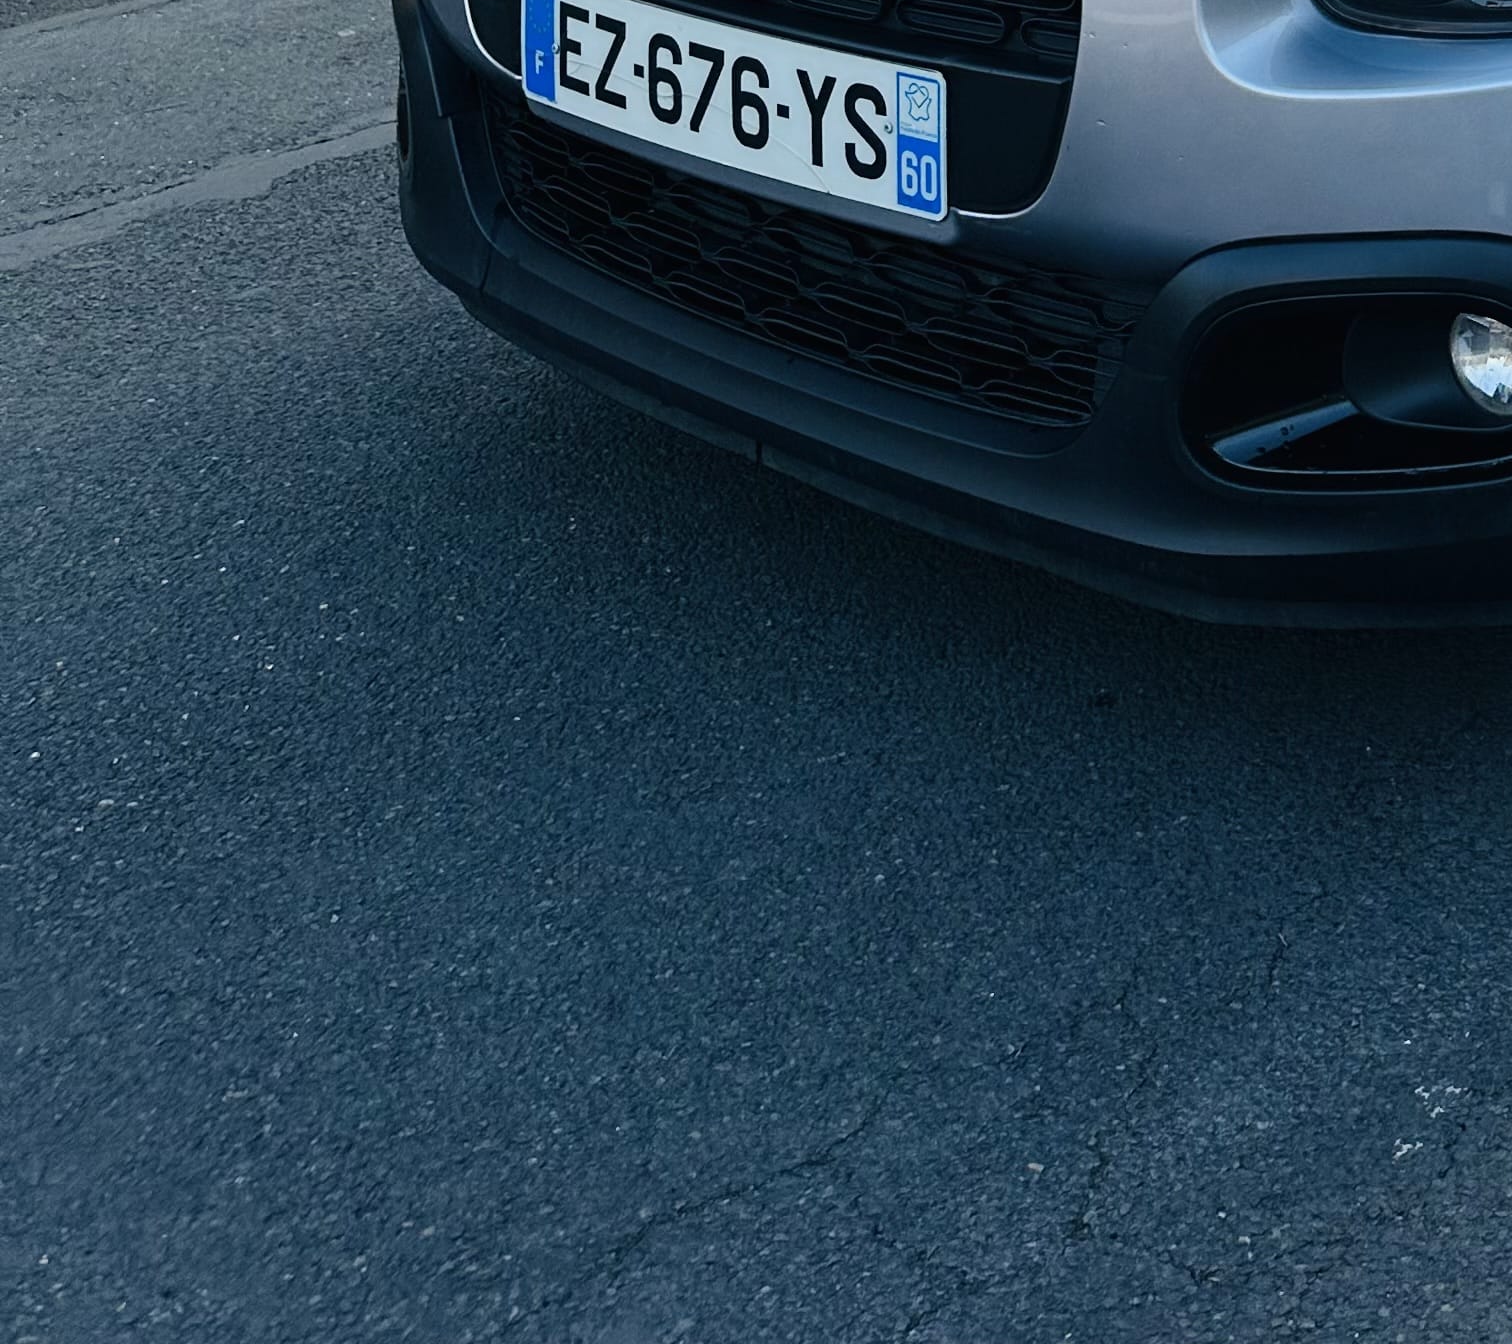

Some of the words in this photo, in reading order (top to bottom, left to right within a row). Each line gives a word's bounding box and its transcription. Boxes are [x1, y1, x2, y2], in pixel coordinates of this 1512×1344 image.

[535, 49, 545, 74] F
[558, 0, 888, 180] EZ-676-YS
[901, 150, 938, 202] 60
